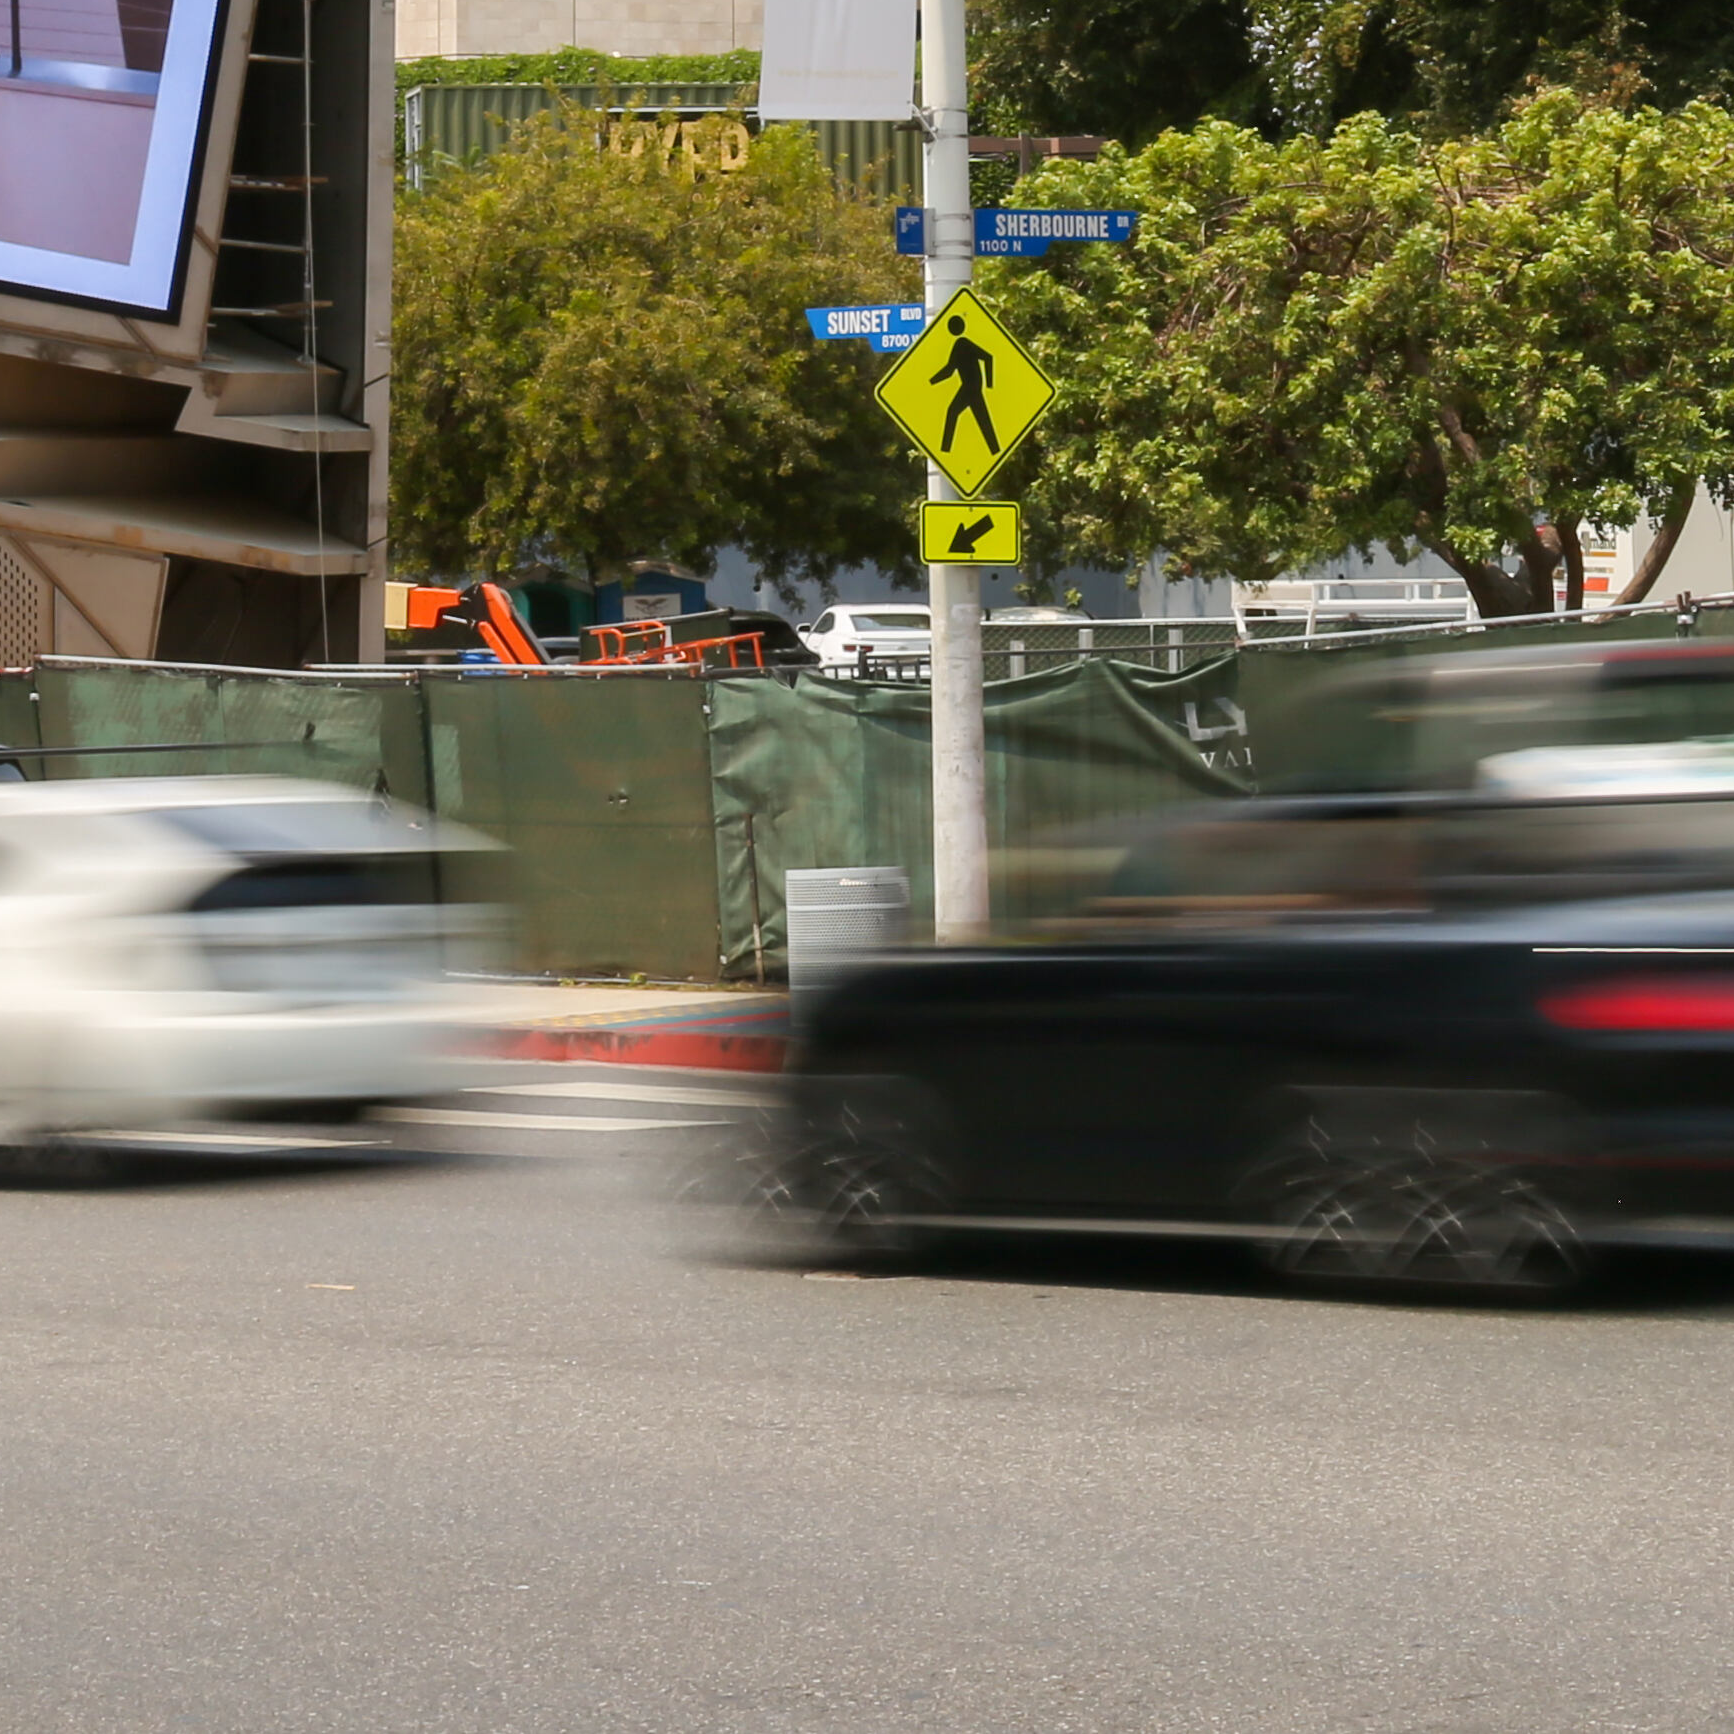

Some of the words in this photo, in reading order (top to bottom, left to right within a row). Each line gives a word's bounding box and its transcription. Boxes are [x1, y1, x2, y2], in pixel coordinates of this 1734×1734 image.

[995, 214, 1110, 239] SHERBOURNE
[1117, 216, 1130, 229] DR
[979, 240, 1009, 253] 1100
[1012, 240, 1022, 252] N
[827, 309, 892, 335] SUNSET
[900, 308, 922, 322] BLVD
[881, 334, 909, 348] 8700
